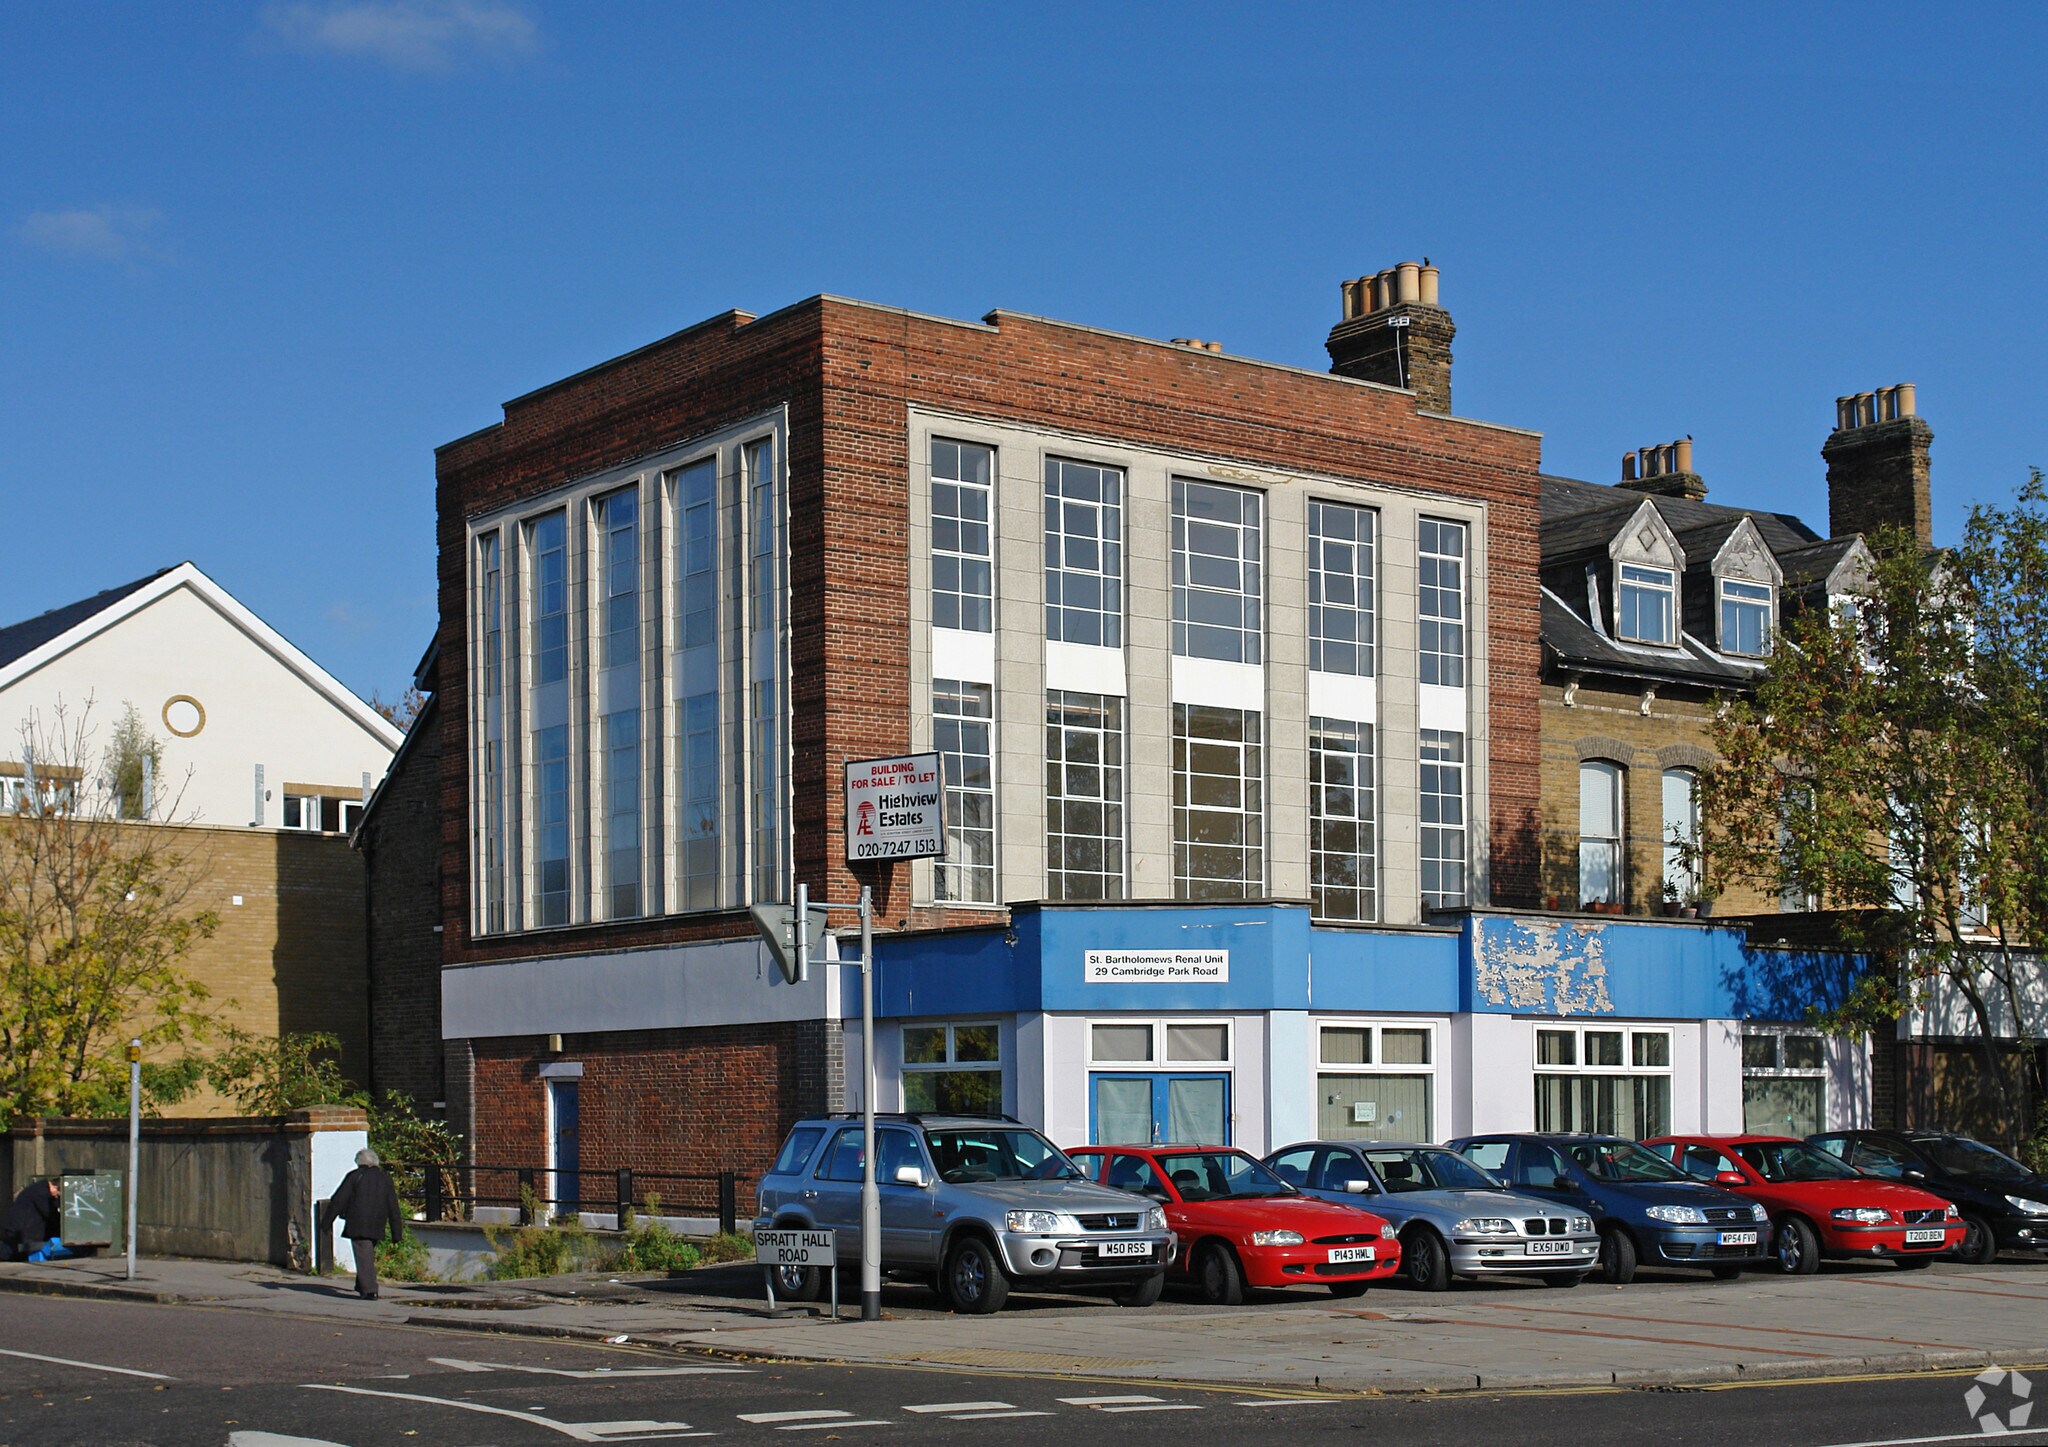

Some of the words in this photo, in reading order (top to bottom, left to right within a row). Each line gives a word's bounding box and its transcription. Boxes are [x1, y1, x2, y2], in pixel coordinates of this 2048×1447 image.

[871, 762, 914, 775] BUILDING
[851, 779, 869, 789] FOR
[871, 776, 895, 788] SALE
[904, 775, 916, 784] TO
[918, 772, 935, 783] LET
[879, 792, 938, 809] Highview
[880, 811, 923, 827] Estates
[915, 839, 936, 853] 1513
[1089, 955, 1102, 964] St.
[1105, 955, 1172, 964] Bartholomews
[1175, 955, 1201, 964] Renal
[1205, 955, 1223, 964] Unit
[1095, 967, 1108, 976] 29
[1111, 967, 1165, 977] Cambridge
[1168, 967, 1190, 976] Park
[1193, 967, 1218, 976] Road
[757, 1232, 797, 1247] SPRATT
[802, 1233, 830, 1247] HALL
[1722, 1234, 1741, 1243] WP54
[1909, 1231, 1928, 1241] T200
[1929, 1231, 1943, 1240] BEN
[1127, 1242, 1146, 1254] RSS
[1533, 1242, 1553, 1253] EX51
[778, 1248, 809, 1262] ROAD
[1334, 1250, 1353, 1260] P143
